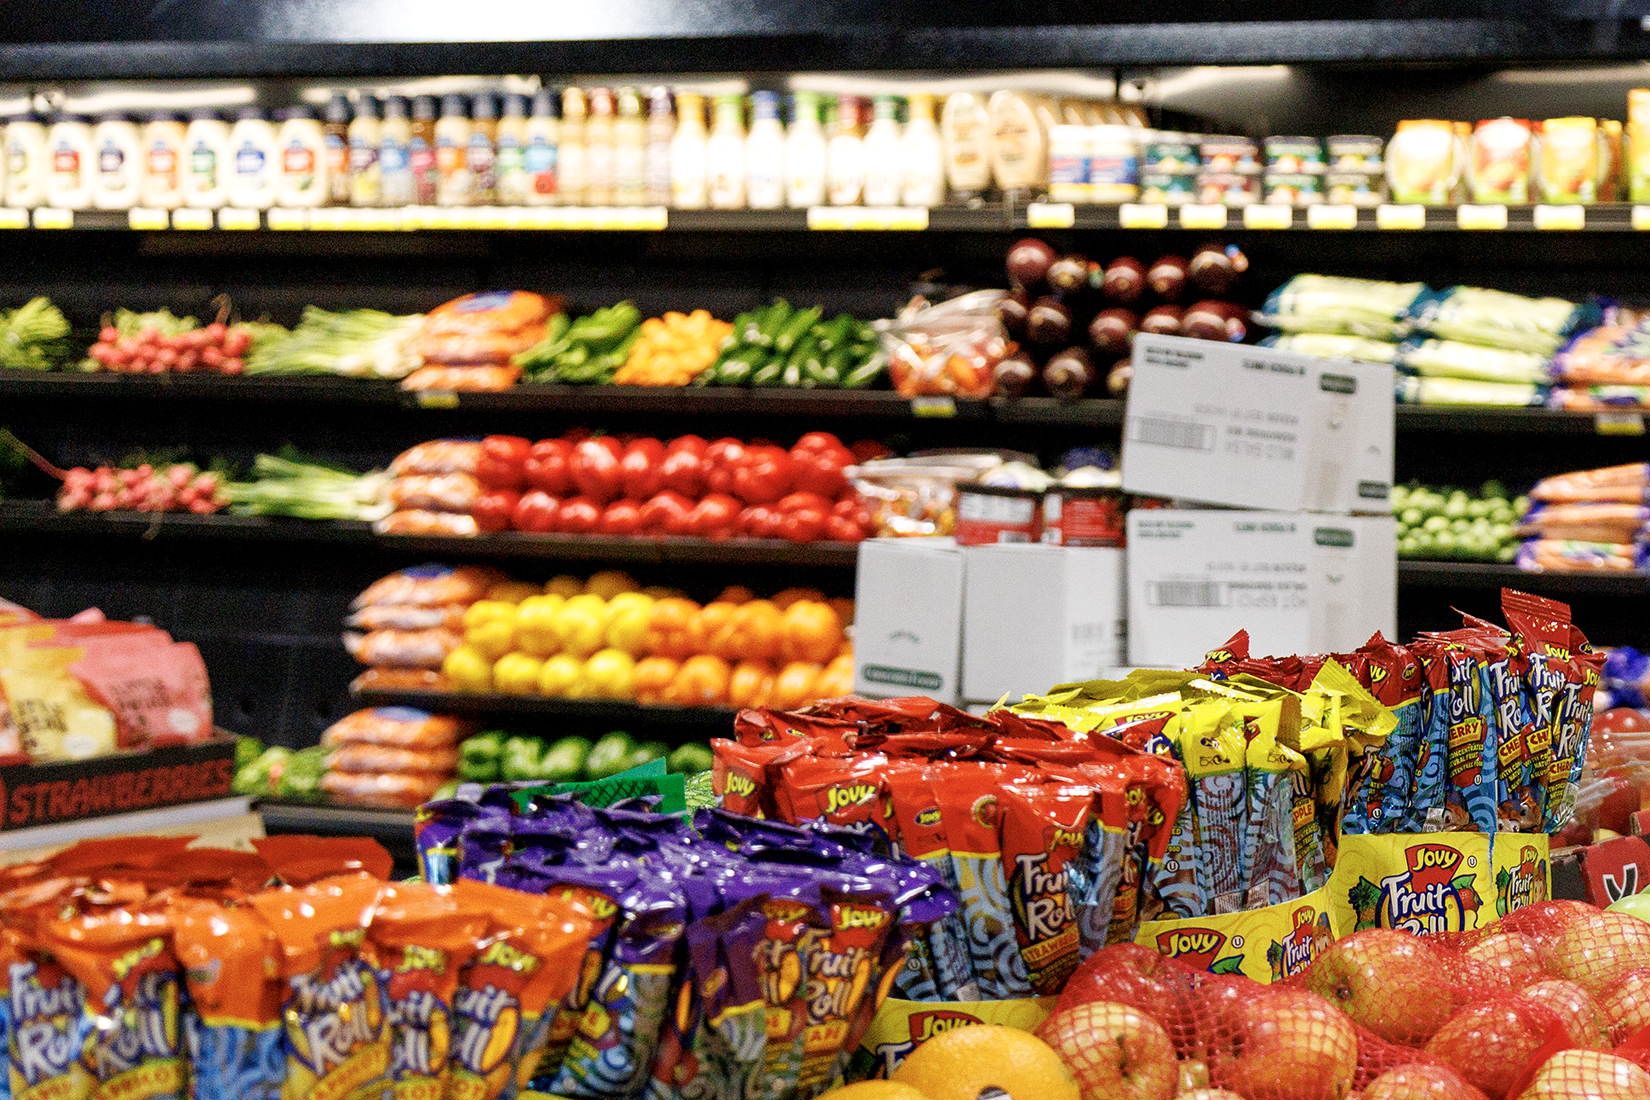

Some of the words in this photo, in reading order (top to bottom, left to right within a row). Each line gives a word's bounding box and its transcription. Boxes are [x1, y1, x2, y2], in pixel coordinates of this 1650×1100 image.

[1490, 658, 1521, 698] Frui
[1529, 651, 1567, 691] Fruit
[1450, 722, 1481, 740] ERRY
[1501, 701, 1522, 739] Ro
[1500, 738, 1521, 757] CHE
[1381, 872, 1452, 918] Fruit
[1509, 865, 1533, 896] Fruit
[1282, 930, 1313, 967] Fruit
